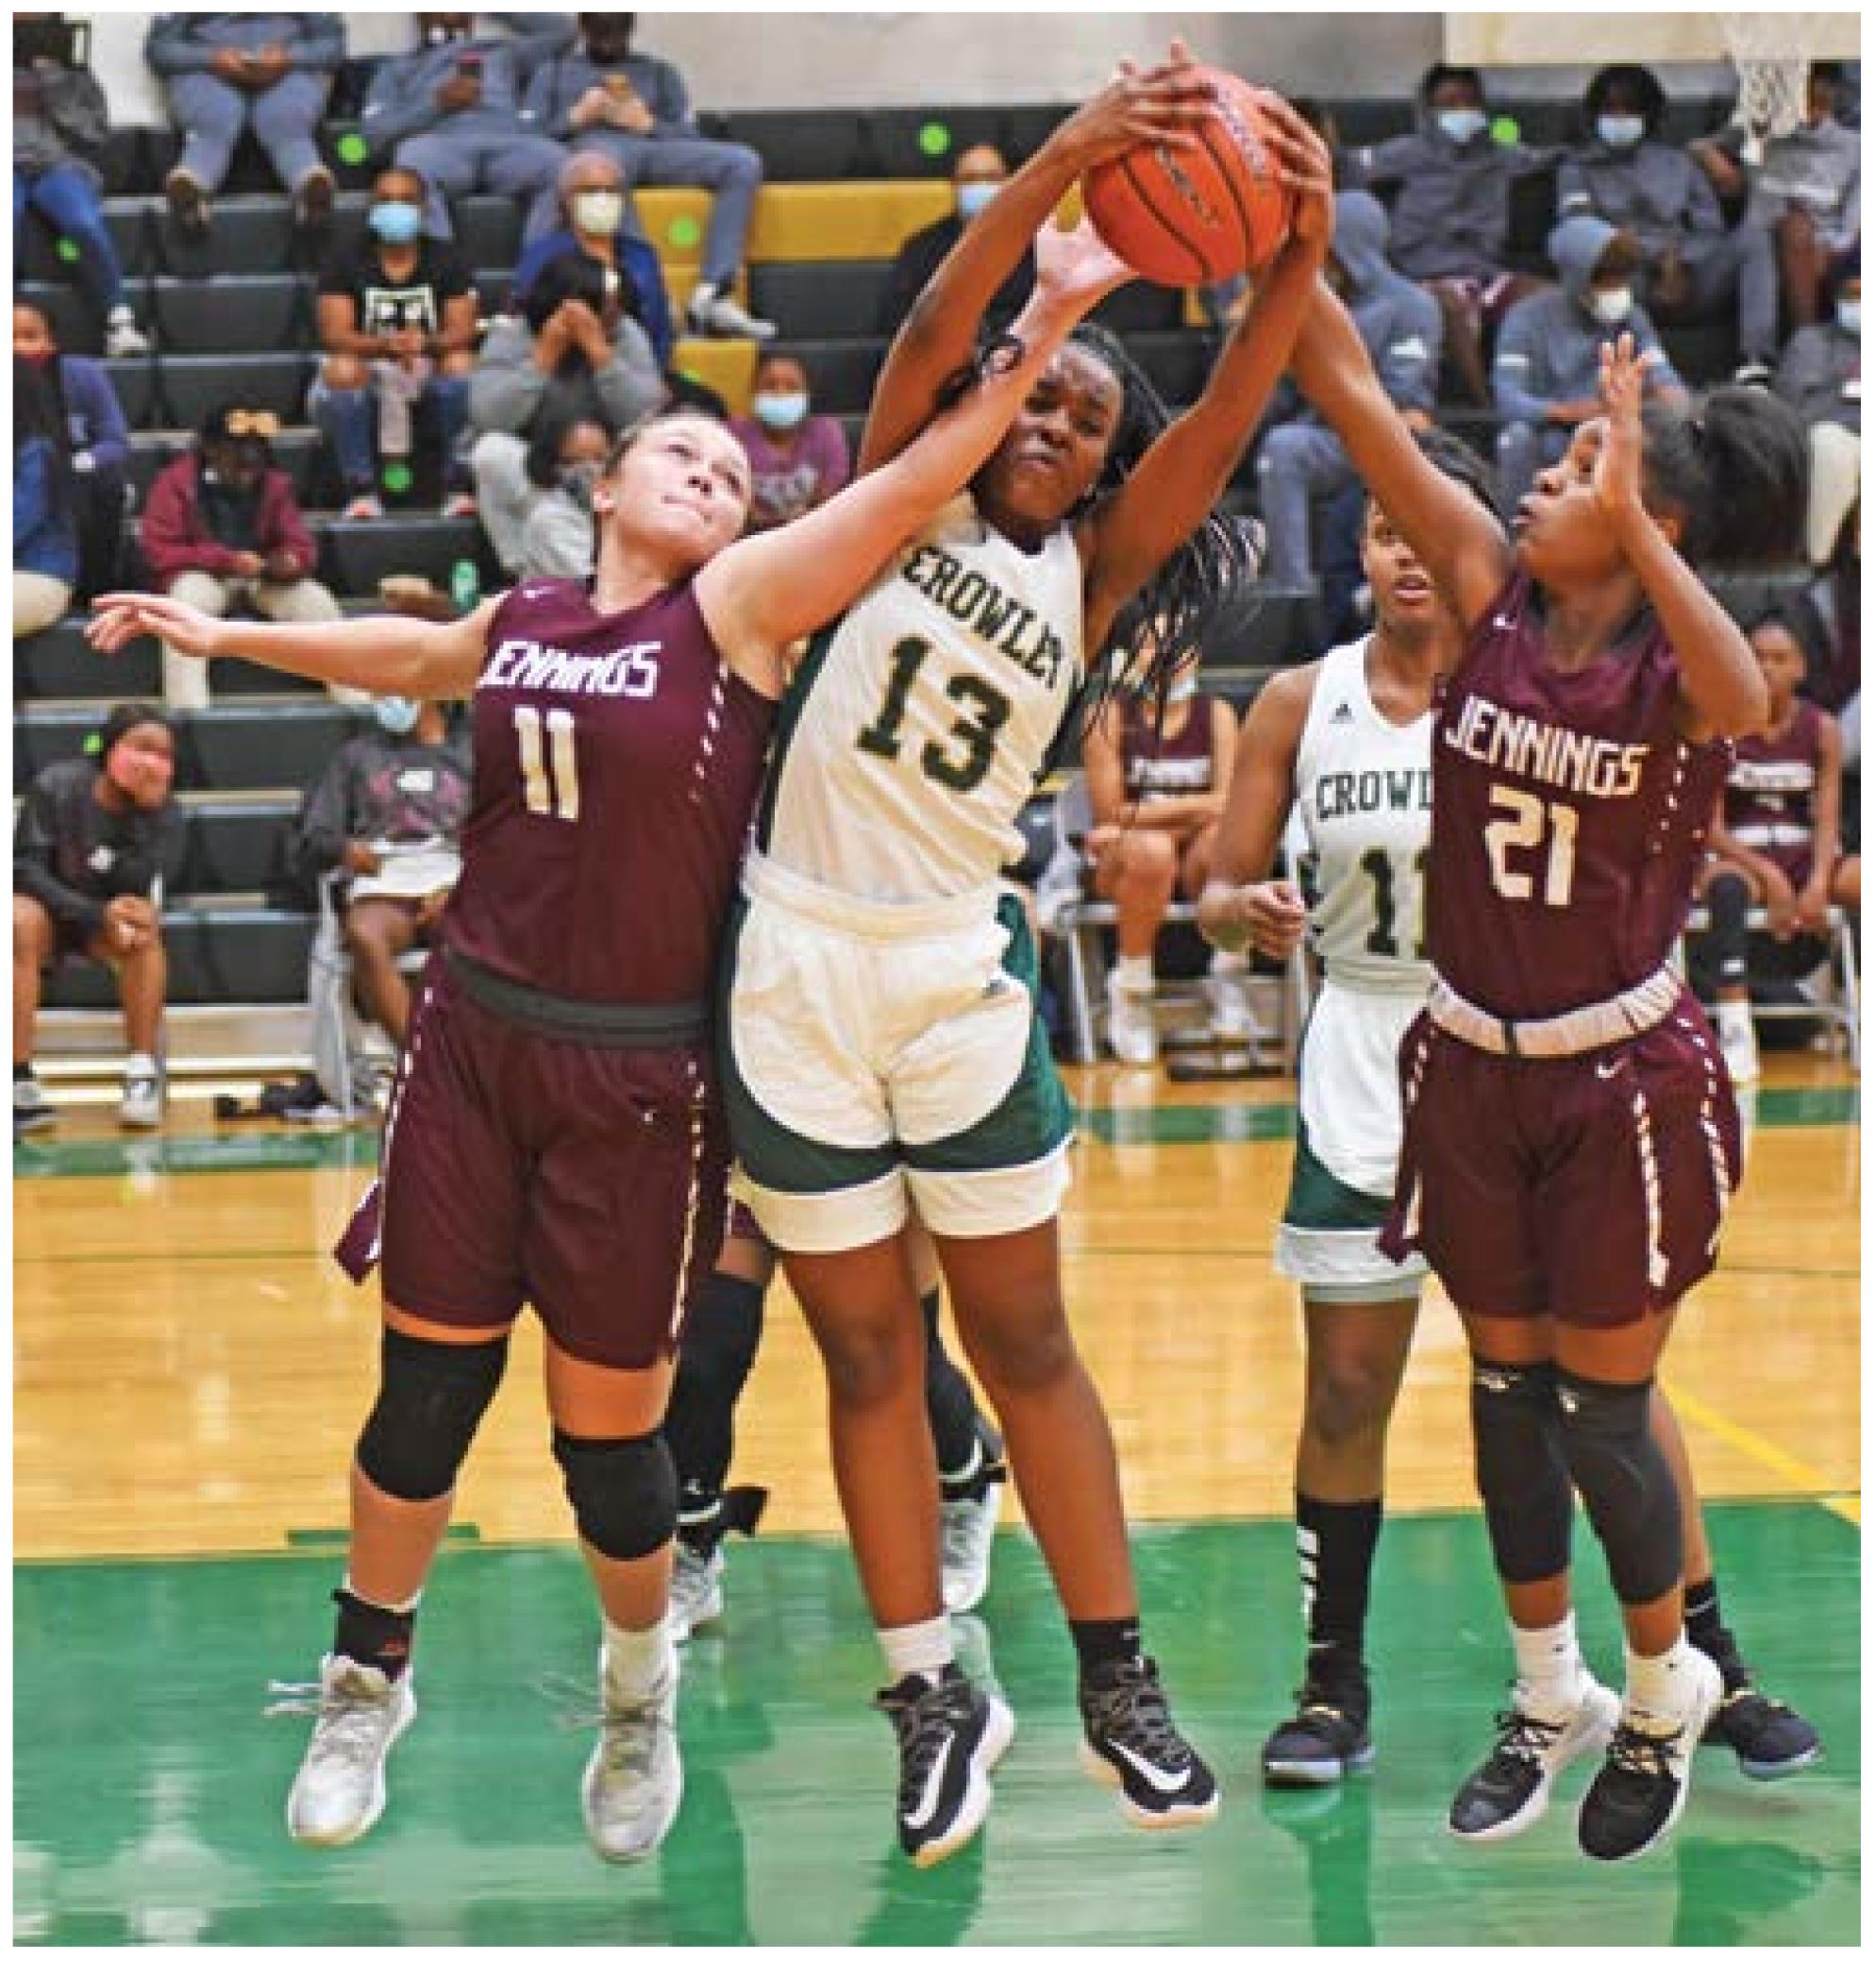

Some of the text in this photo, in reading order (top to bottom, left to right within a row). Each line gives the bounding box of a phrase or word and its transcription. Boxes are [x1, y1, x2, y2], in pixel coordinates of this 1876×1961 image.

[513, 704, 578, 821] 11
[857, 633, 1012, 791] 13
[1445, 693, 1652, 796] JENNINGS
[1483, 782, 1580, 906] 21
